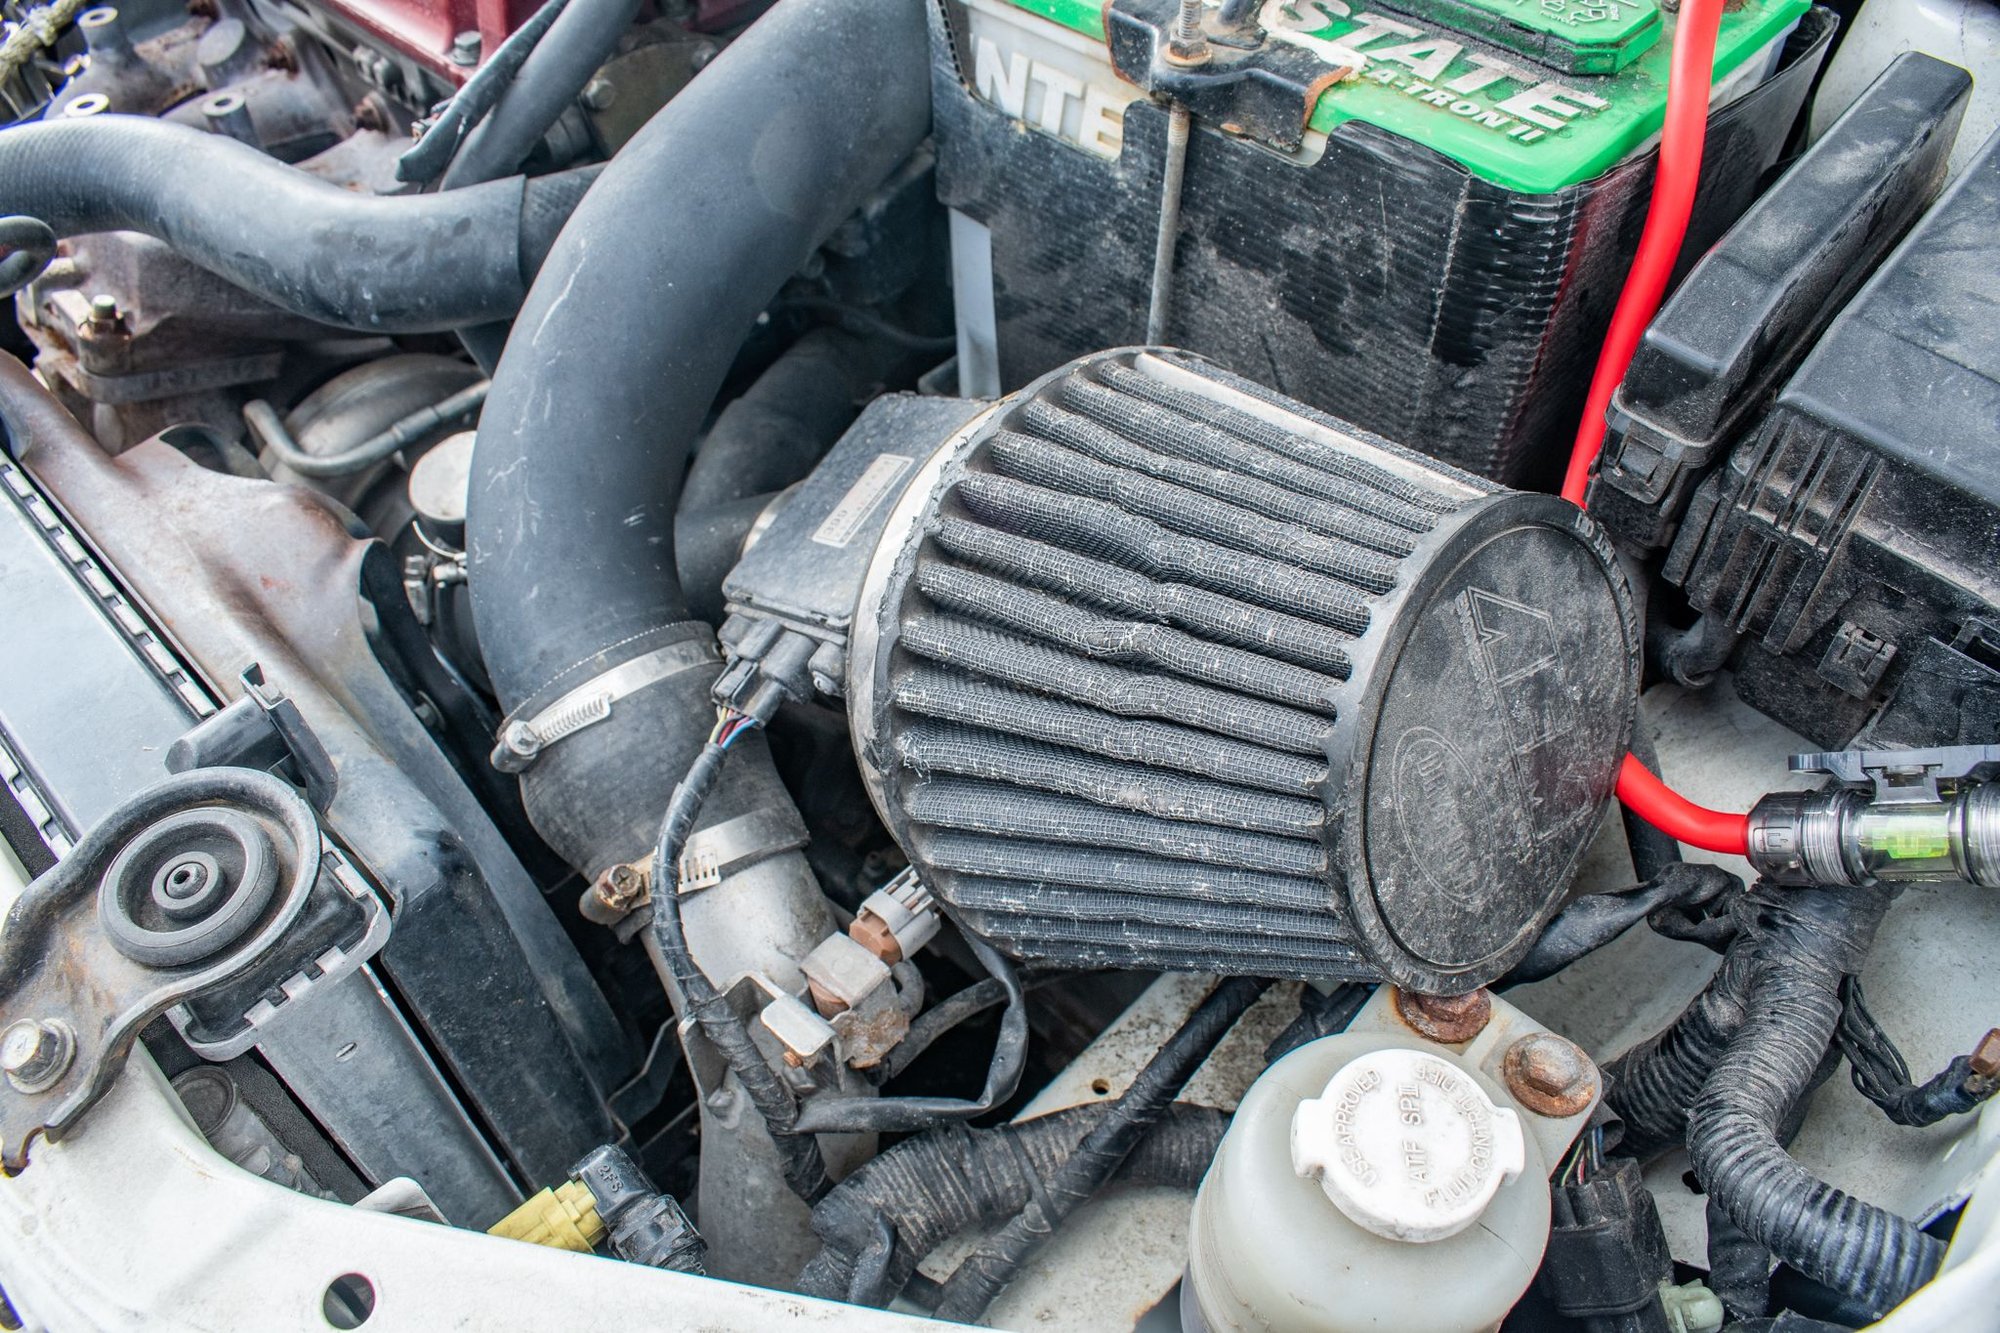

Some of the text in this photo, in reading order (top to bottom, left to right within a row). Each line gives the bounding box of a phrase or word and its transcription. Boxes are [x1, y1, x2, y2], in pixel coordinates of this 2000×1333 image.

[970, 34, 1128, 162] NTE
[1265, 0, 1608, 131] STATE
[1355, 60, 1511, 129] A-TRON
[1335, 1069, 1382, 1187] USE APPROVED
[1402, 1140, 1428, 1183] ATF
